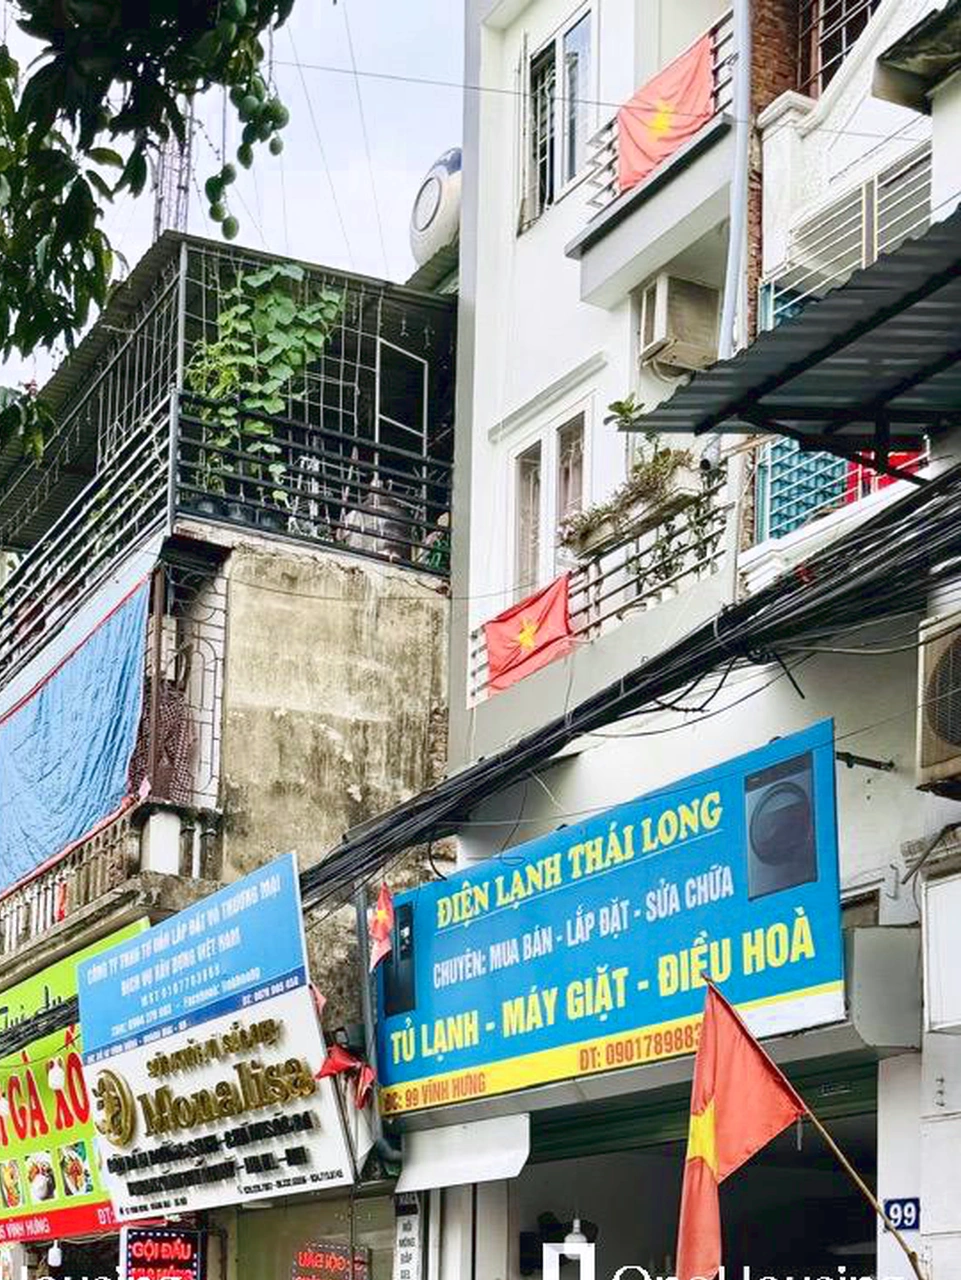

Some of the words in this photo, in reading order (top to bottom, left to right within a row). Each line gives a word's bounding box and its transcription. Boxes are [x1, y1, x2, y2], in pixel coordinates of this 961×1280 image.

[437, 881, 489, 929] ĐIỆN
[495, 853, 562, 909] LẠNH
[568, 822, 634, 879] THÁI
[642, 791, 723, 853] LONG
[433, 947, 486, 990] CHUYÊN:
[489, 938, 519, 970] MUA
[522, 922, 553, 961] BÁN
[566, 910, 594, 946] LẮP
[600, 897, 631, 941] ĐẶT
[645, 878, 681, 923] SỬA
[685, 864, 735, 910] CHỮA
[391, 1013, 416, 1065] TỦ
[420, 1011, 480, 1063] LẠNH
[501, 984, 559, 1039] MÁY
[566, 964, 630, 1022] GIẶT
[658, 930, 732, 997] ĐIỀU
[742, 907, 816, 973] HOÀ
[8, 1051, 49, 1140] GÀ
[138, 1059, 316, 1136] Monalisa
[405, 1088, 419, 1108] 99
[422, 1079, 449, 1104] VĨNH
[578, 1047, 603, 1072] ĐT:
[132, 1239, 159, 1262] GỘI
[890, 1202, 916, 1228] 99
